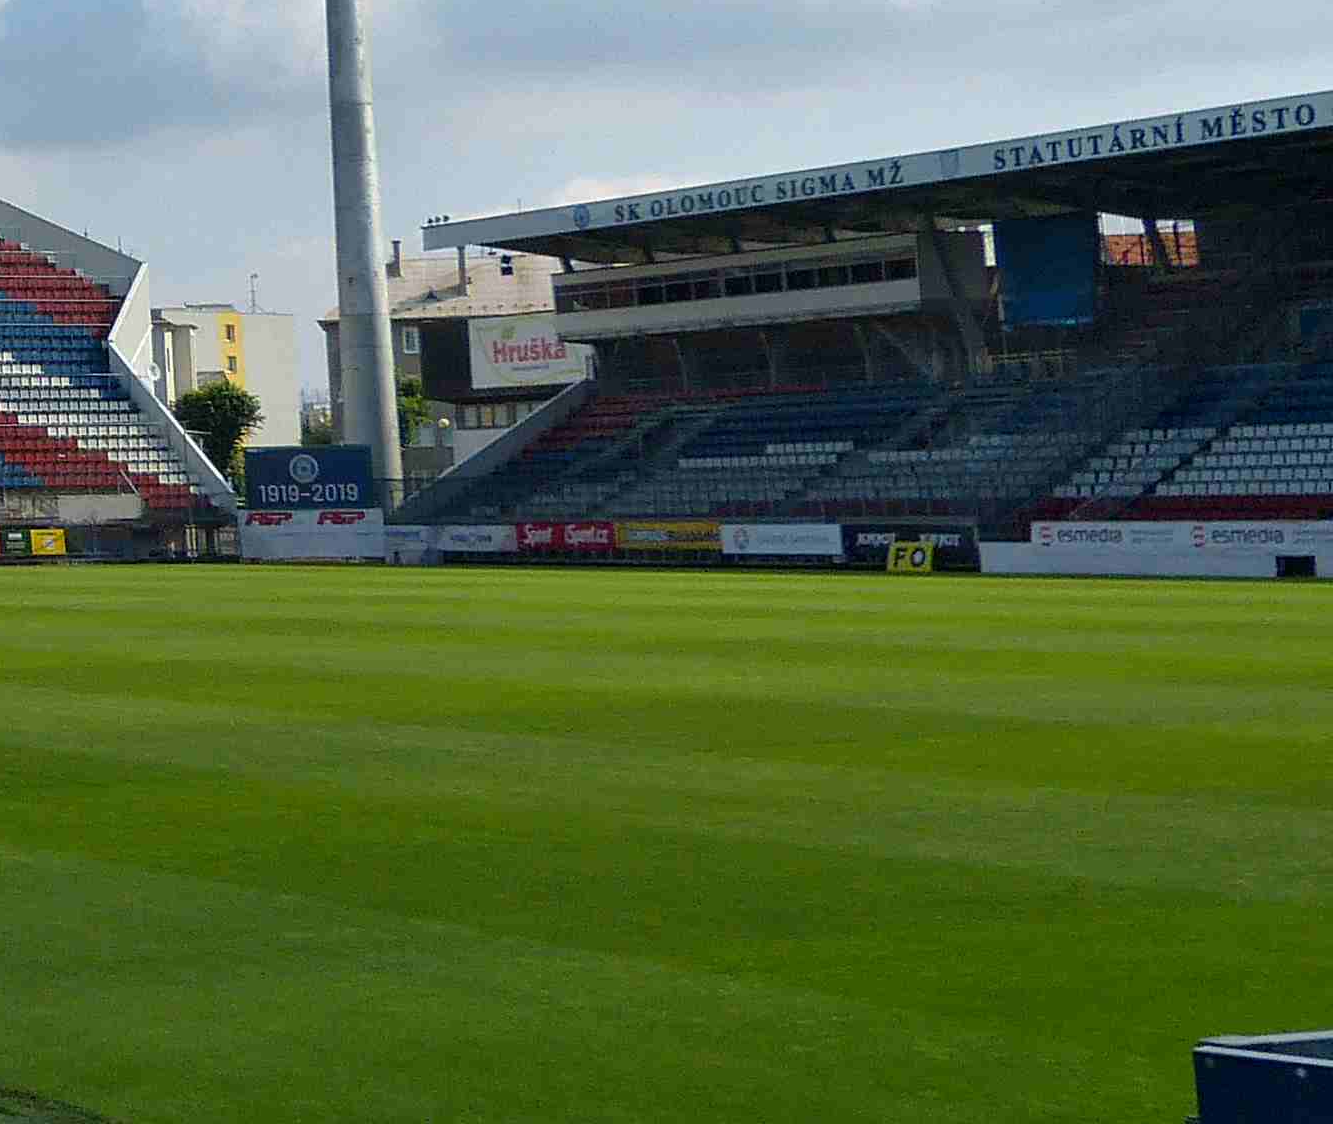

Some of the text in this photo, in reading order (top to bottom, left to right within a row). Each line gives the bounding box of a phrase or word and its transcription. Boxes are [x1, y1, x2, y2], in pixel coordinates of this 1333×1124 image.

[993, 103, 1317, 170] STATUTÁRNÍ MĚSTO
[613, 204, 641, 223] SK
[650, 185, 765, 217] OLOMOUC
[775, 174, 855, 199] SIGMA
[492, 336, 566, 364] Hruška
[258, 483, 358, 503] 1919-2019
[1057, 528, 1123, 544] esmedia
[1211, 527, 1284, 544] esmedia
